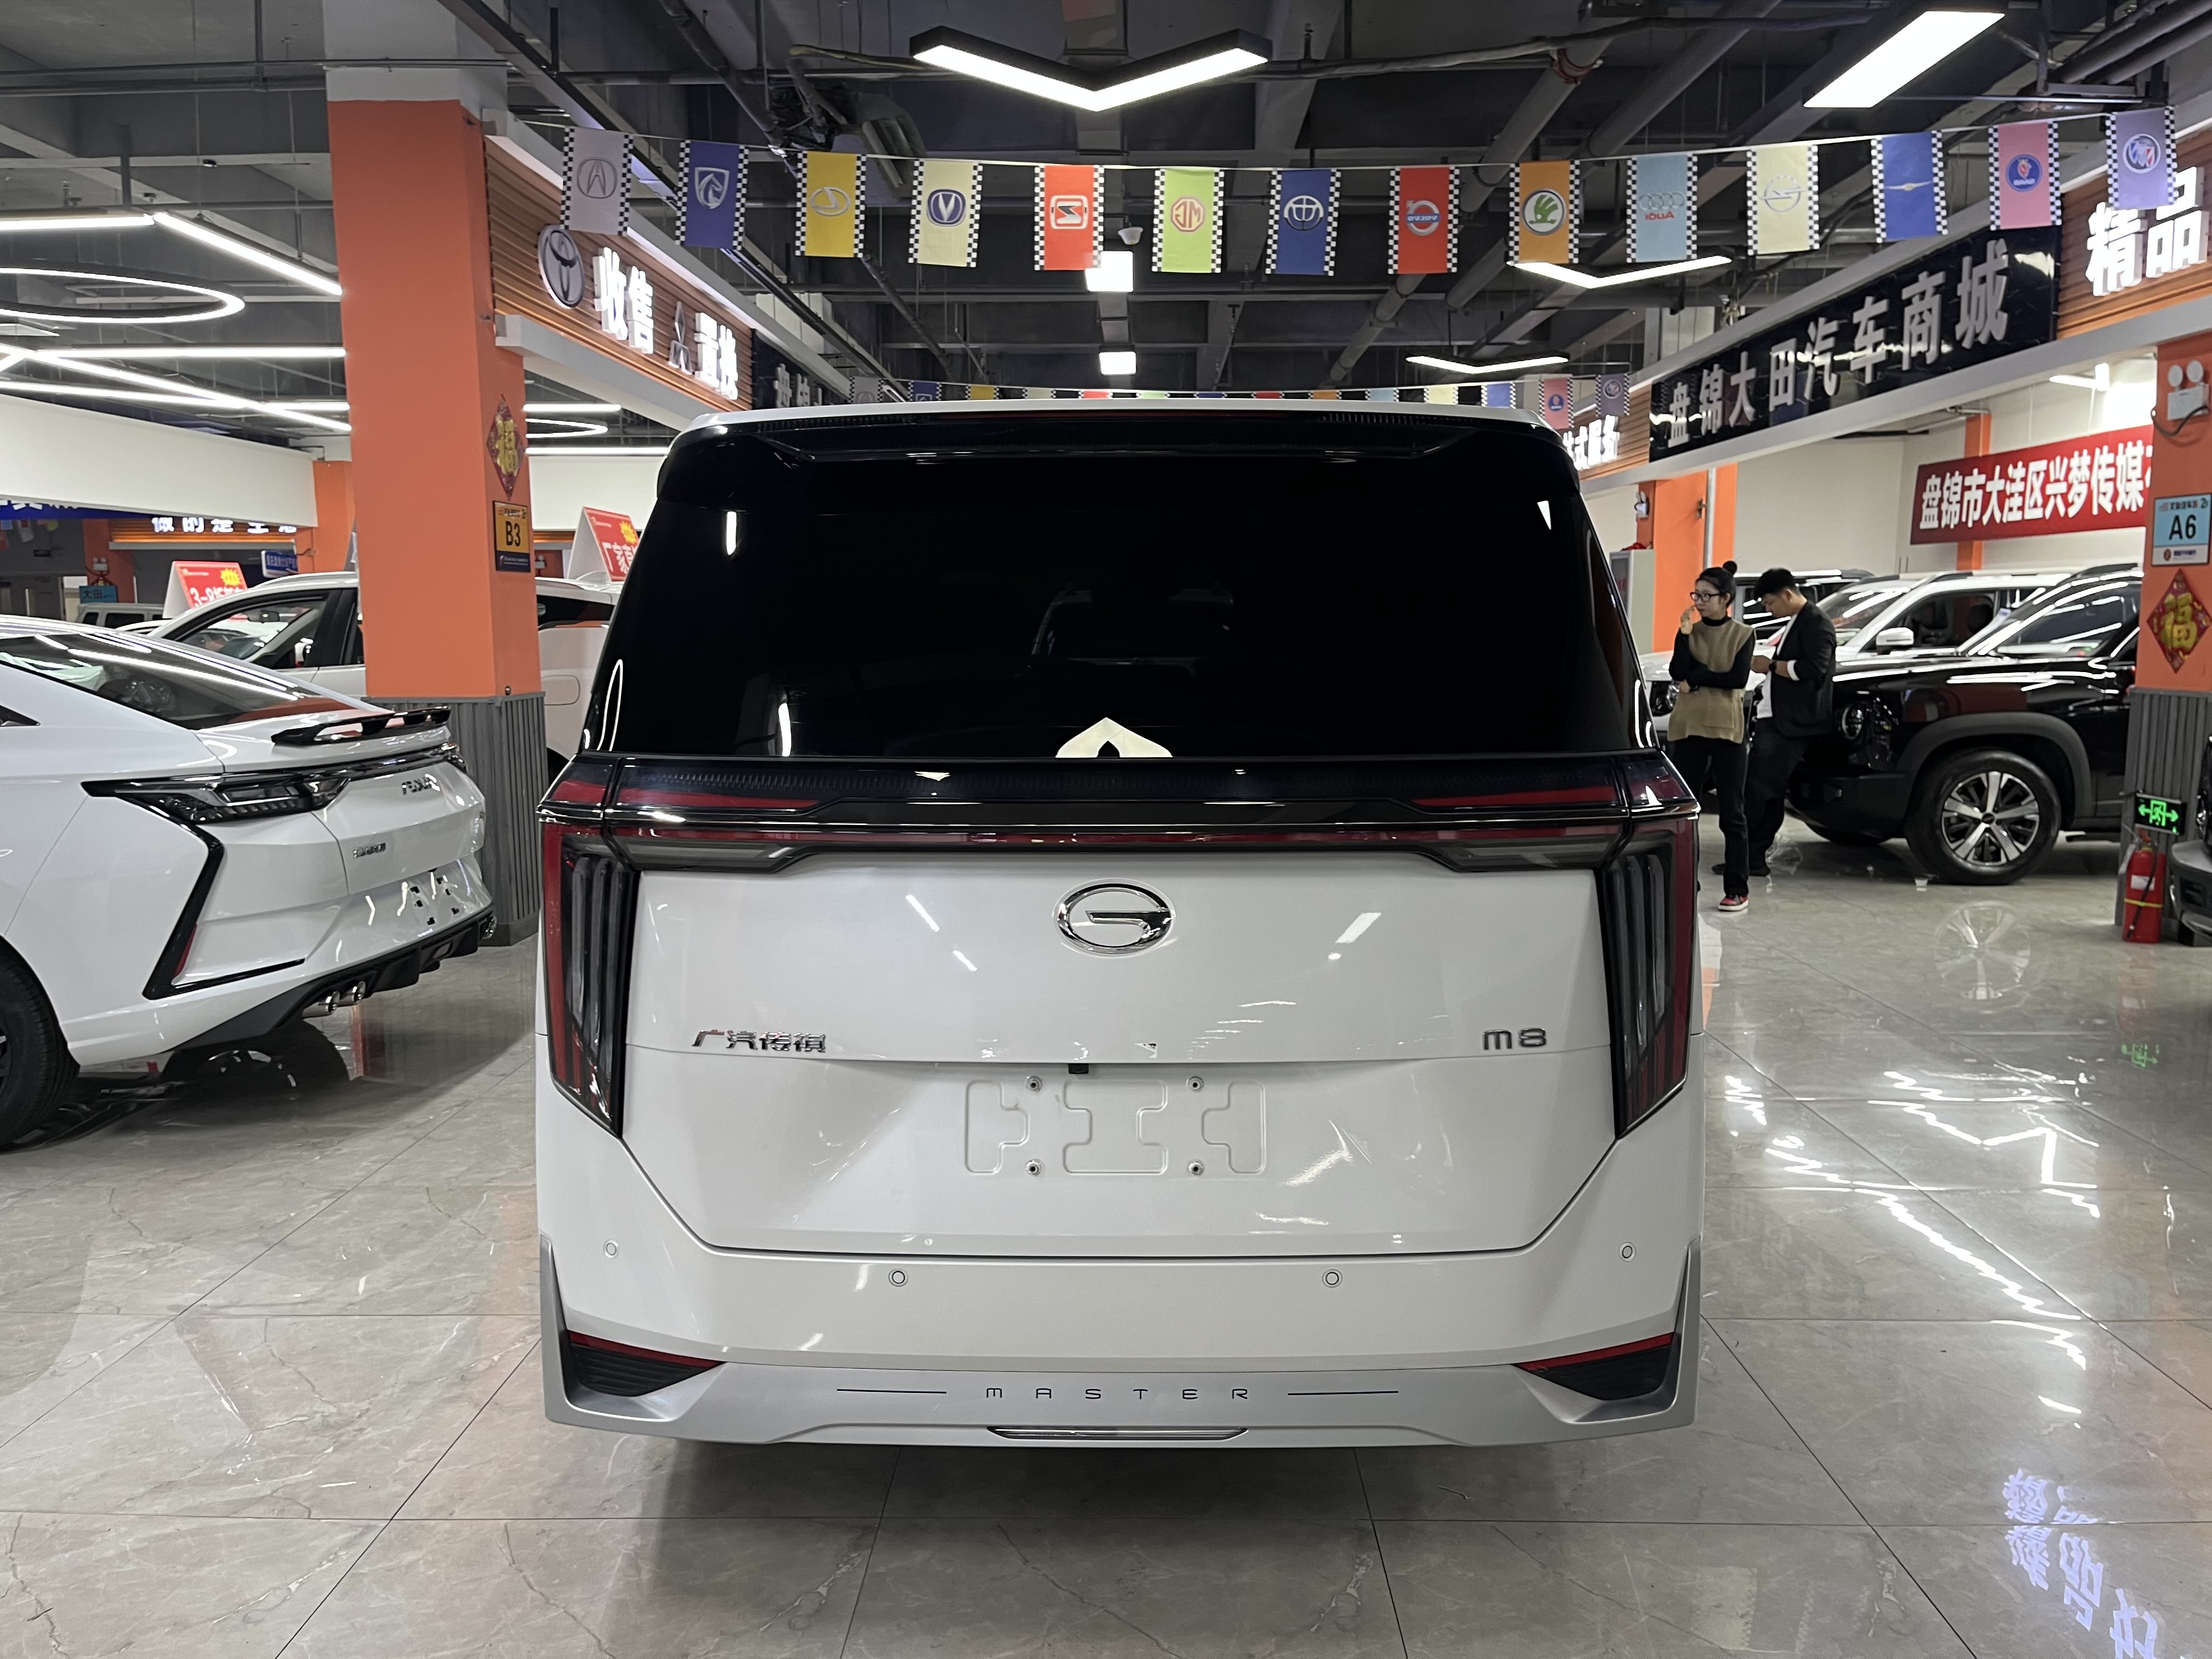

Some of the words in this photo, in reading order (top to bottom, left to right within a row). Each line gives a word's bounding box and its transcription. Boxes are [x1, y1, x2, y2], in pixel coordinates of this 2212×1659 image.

[2086, 166, 2210, 297] 精品
[593, 246, 653, 354] 收售
[1667, 238, 2009, 448] 盘锦大田汽车商城
[1920, 439, 2152, 530] 盘锦市大洼区兴梦传媒
[506, 521, 521, 546] B3
[2169, 514, 2197, 540] A6
[2161, 591, 2198, 652] 福
[691, 1029, 826, 1053] 广汽传祺
[985, 1387, 1249, 1400] MASTER
